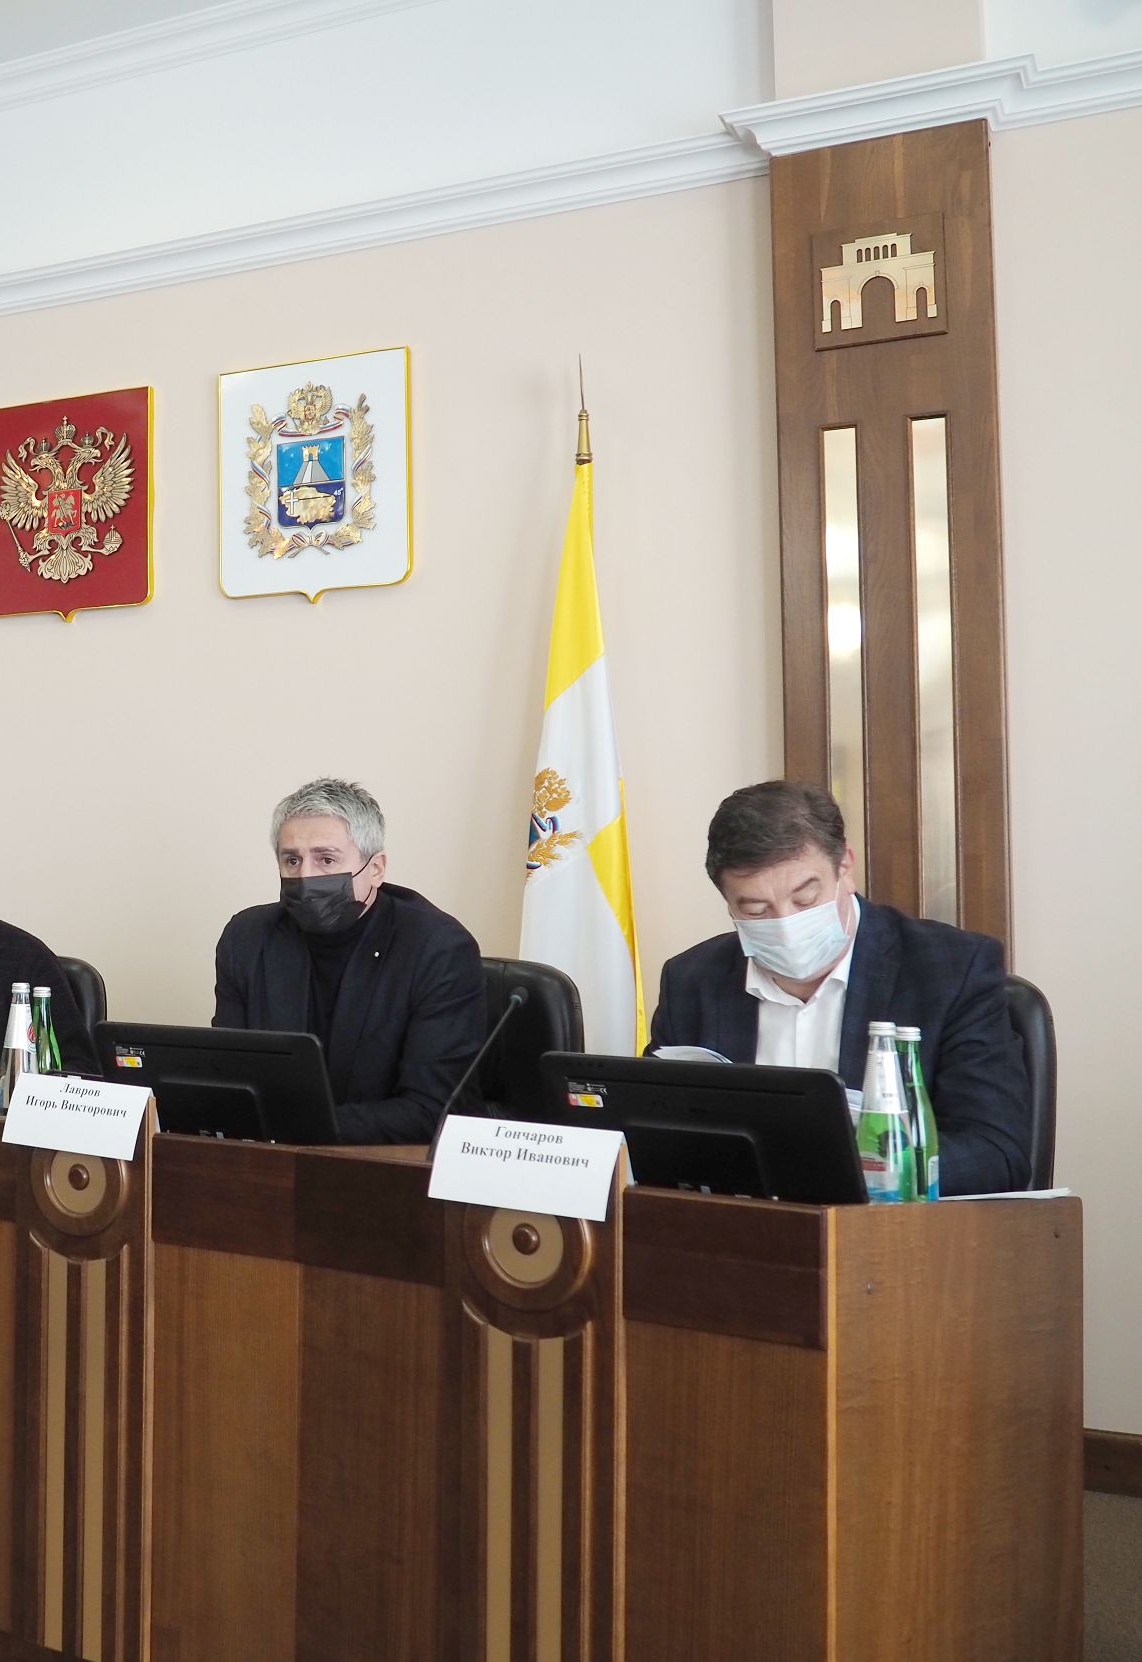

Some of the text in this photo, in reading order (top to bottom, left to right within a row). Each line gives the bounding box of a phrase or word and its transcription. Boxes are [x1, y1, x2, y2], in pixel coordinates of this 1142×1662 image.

[59, 1083, 101, 1098] Лавров
[25, 1095, 128, 1118] Игорь Викторович
[494, 1126, 564, 1145] Гончаров
[461, 1141, 590, 1168] Виктор Иванович
